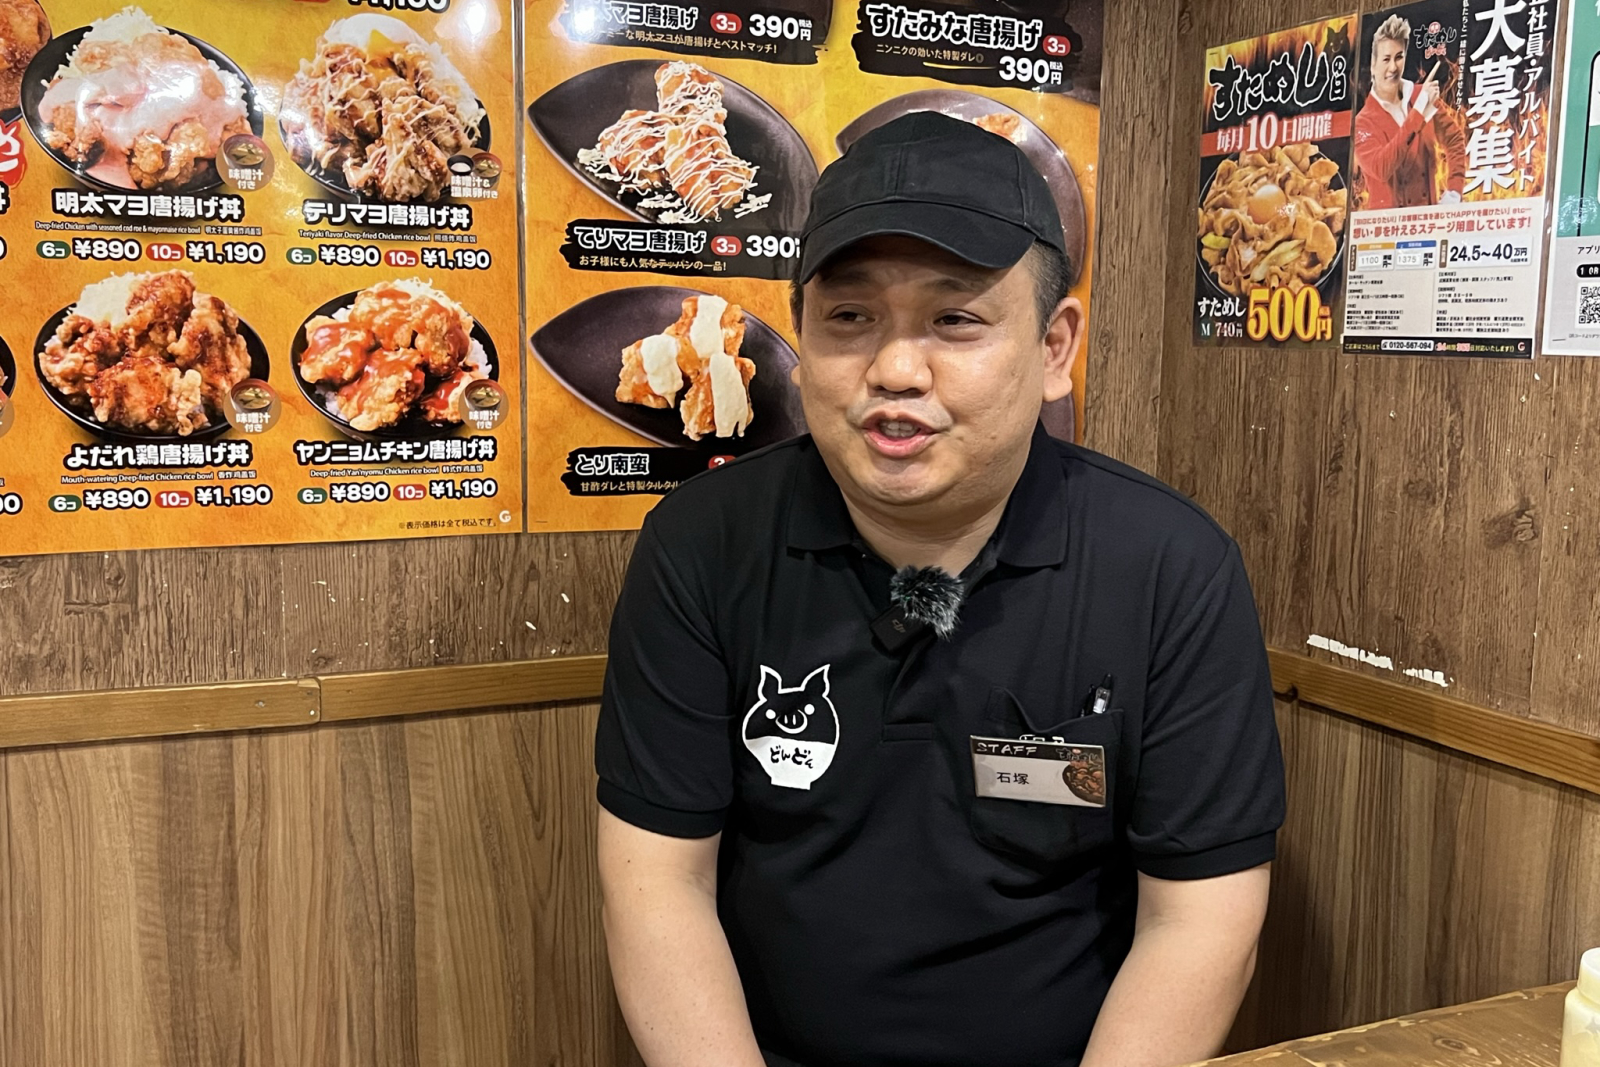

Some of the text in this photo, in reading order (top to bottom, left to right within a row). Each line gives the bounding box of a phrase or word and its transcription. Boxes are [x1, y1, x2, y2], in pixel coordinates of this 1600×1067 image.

[866, 4, 1043, 51] すたみな唐揚げ
[1463, 0, 1527, 194] 大募集
[1519, 0, 1550, 192] 社員・アルバイト
[1217, 113, 1332, 151] 毎月10日開催
[55, 191, 242, 219] 明太マヨ唐揚げ丼
[305, 202, 470, 228] テリマヨ唐揚げ丼
[74, 240, 140, 259] ¥890
[189, 242, 263, 263] ¥1,190
[574, 226, 706, 254] てりマヨ唐揚げ
[321, 247, 379, 265] ¥890
[423, 249, 490, 269] ¥1,190
[1198, 297, 1247, 317] すためし
[1201, 323, 1210, 336] M
[67, 443, 250, 468] よだれ鶏唐揚げ丼
[296, 439, 494, 463] ヤンニョムチキン唐揚げ丼
[575, 453, 650, 476] とり南蛮
[332, 483, 389, 501] ¥890
[431, 480, 496, 500] ¥1,190
[581, 480, 685, 492] 甘酢ダレと特製タルタル
[85, 490, 149, 509] ¥890
[196, 487, 270, 509] ¥1,190
[977, 742, 1038, 756] STAFF
[996, 771, 1030, 785] 石塚
